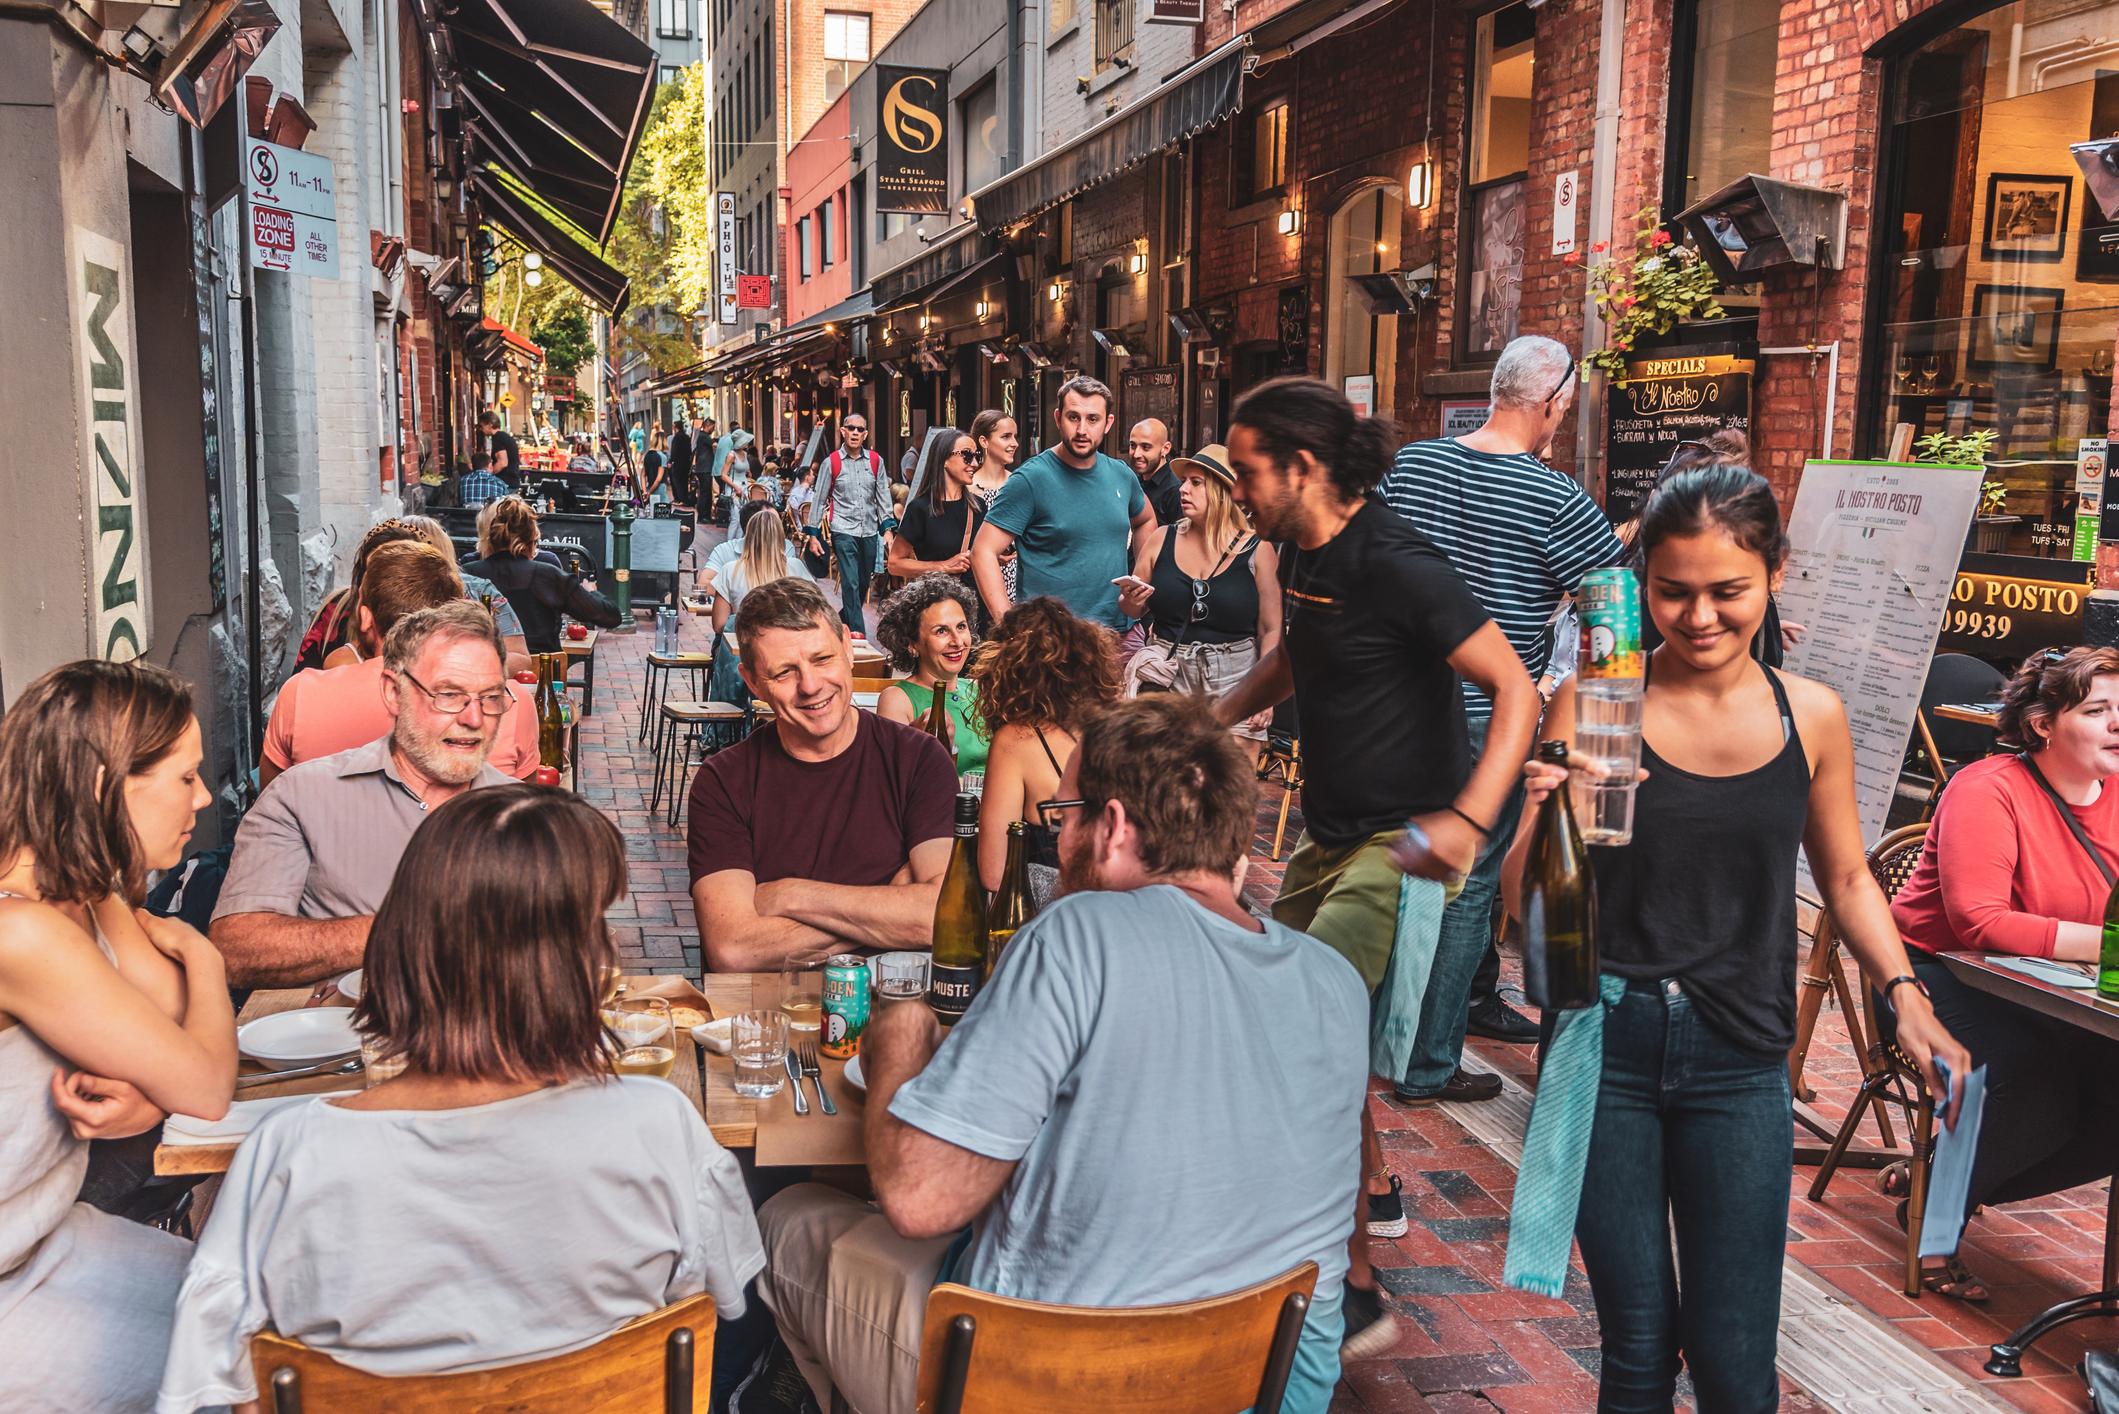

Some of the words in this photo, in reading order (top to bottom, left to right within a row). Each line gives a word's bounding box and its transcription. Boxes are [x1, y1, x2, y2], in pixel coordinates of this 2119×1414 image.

[900, 167, 925, 175] GRILL
[880, 176, 906, 184] STEAK
[909, 177, 945, 186] SEAFOOD
[887, 185, 938, 193] RESTAURANT
[254, 211, 293, 231] LOADING
[257, 227, 292, 248] ZONE
[310, 231, 321, 241] ALL
[305, 241, 327, 252] OTHER
[259, 249, 267, 258] 15
[307, 251, 327, 262] TIMES
[1647, 359, 1706, 376] SPECIALS
[1457, 419, 1475, 429] BEAUTY
[1835, 489, 1846, 509] IL
[1847, 490, 1888, 510] NOSTRO
[1887, 493, 1922, 516] POSTO
[2032, 523, 2052, 533] TUES
[2057, 524, 2070, 534] FRI
[2056, 538, 2071, 547] SAT
[1951, 577, 1974, 602] O
[1984, 580, 2078, 615] POSTO
[933, 978, 972, 998] MUSTE
